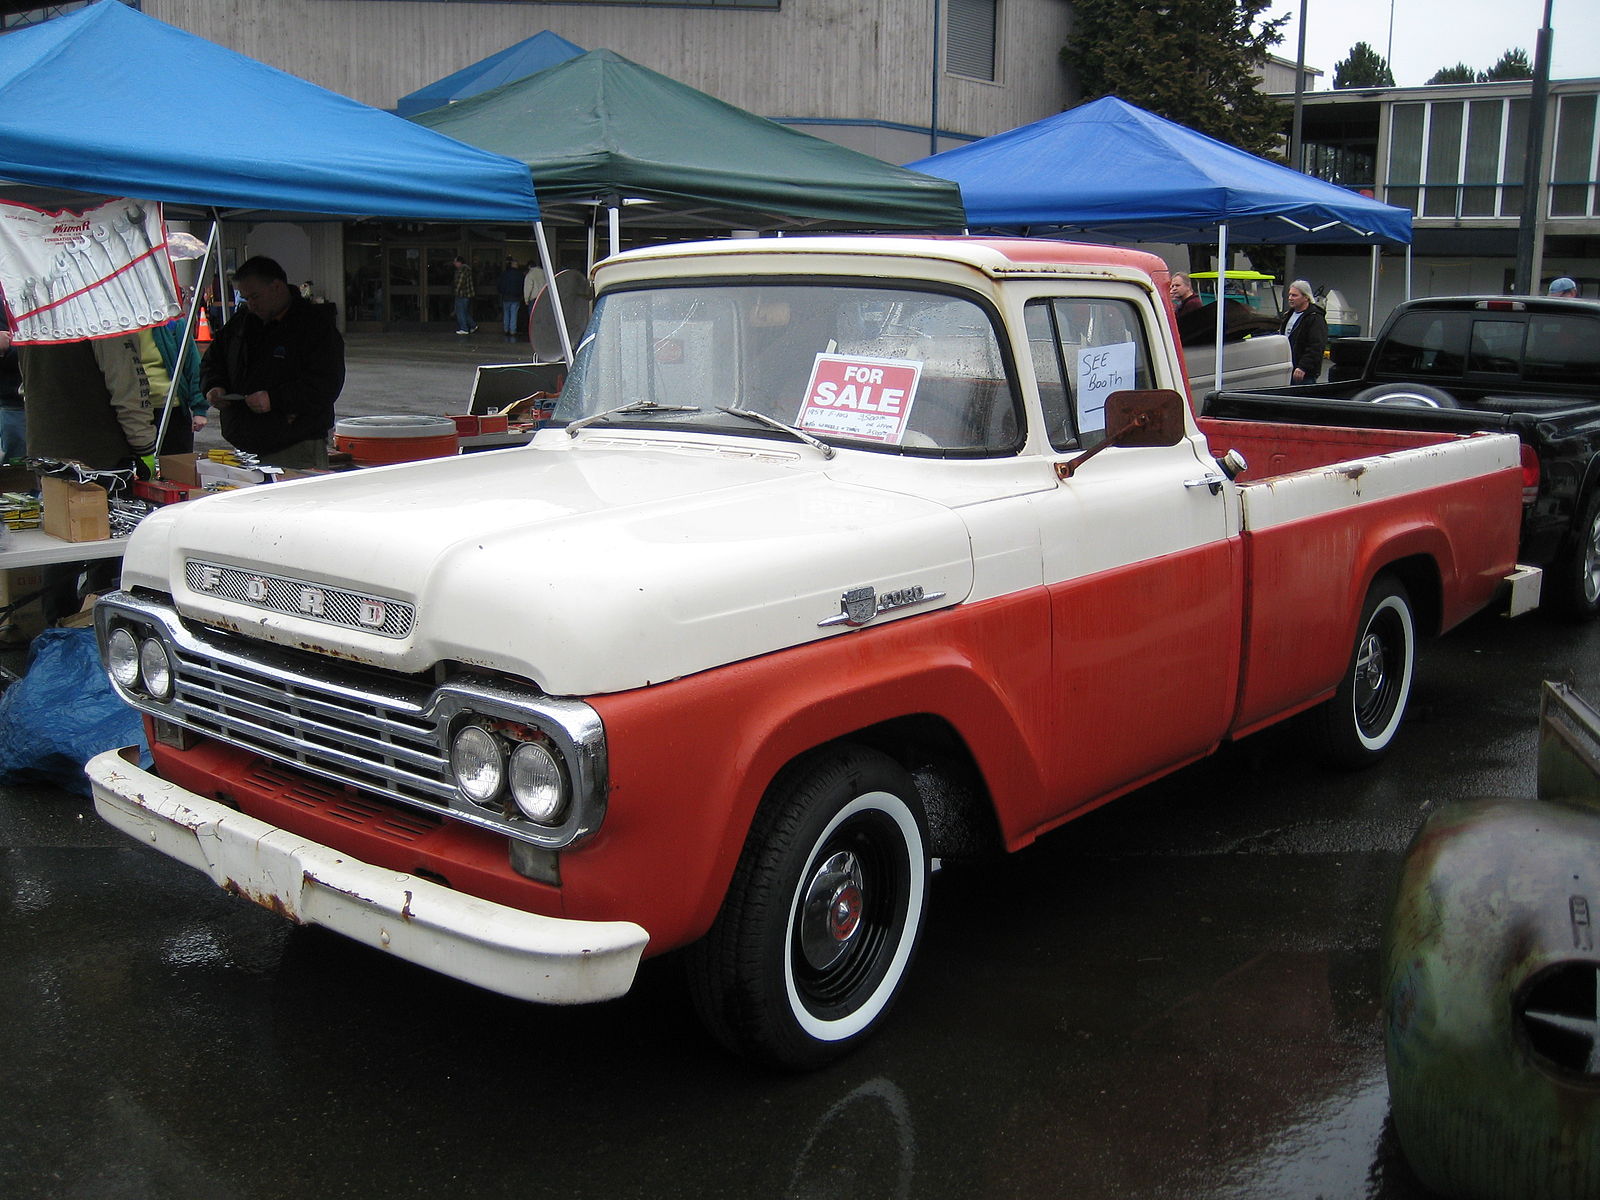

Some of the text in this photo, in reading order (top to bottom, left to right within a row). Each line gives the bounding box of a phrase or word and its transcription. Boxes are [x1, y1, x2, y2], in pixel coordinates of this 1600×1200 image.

[843, 365, 884, 385] FOR
[1082, 352, 1110, 377] SEE
[813, 382, 905, 413] SALE
[202, 566, 386, 628] FORD
[880, 584, 926, 610] FORD
